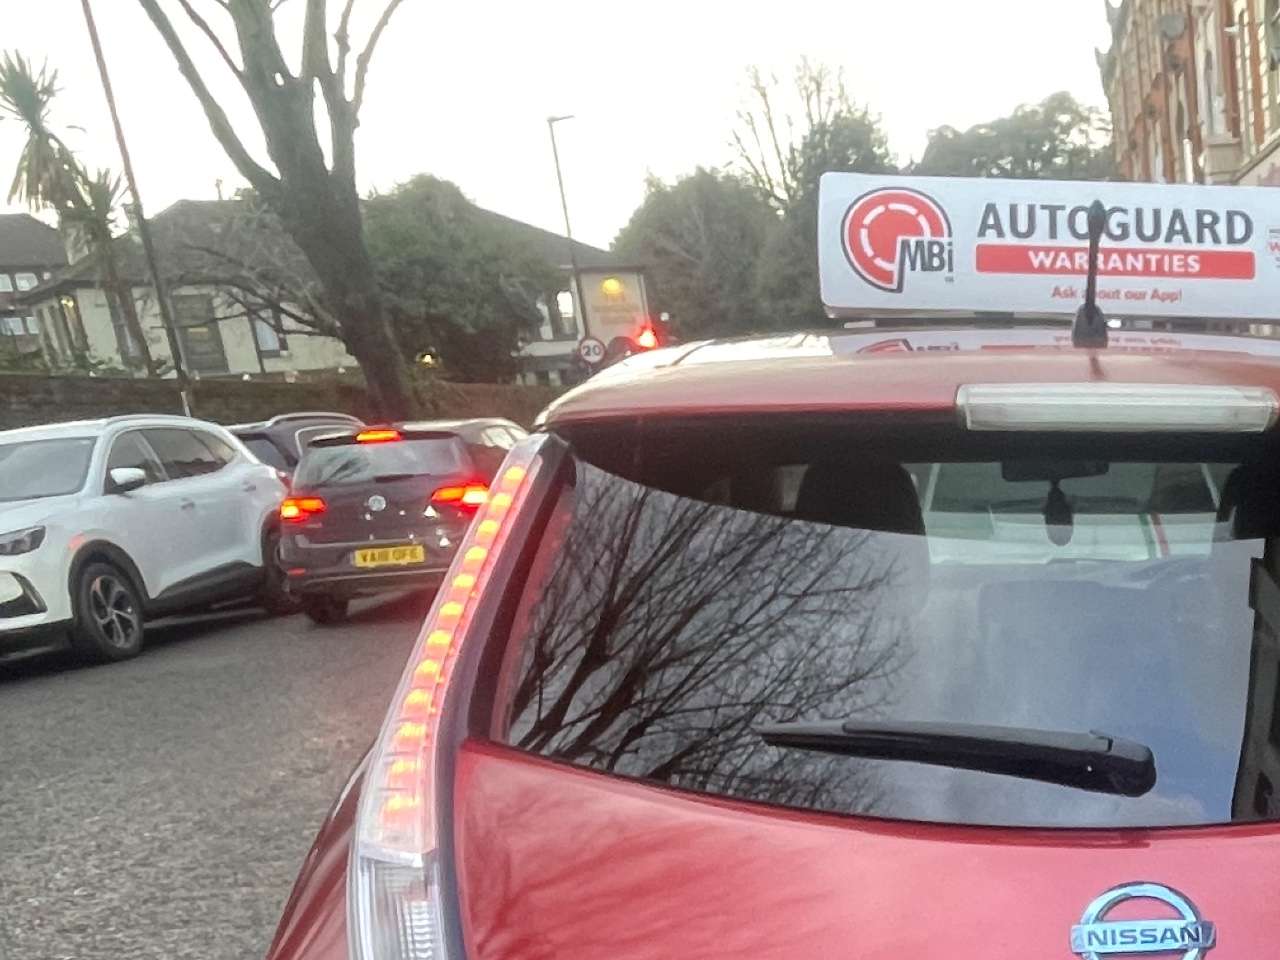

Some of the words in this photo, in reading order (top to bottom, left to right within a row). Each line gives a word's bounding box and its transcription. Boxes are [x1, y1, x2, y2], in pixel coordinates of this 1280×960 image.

[977, 202, 1254, 244] AUTOGUARD
[899, 239, 954, 272] MBi
[1028, 250, 1201, 273] WARRANTIES
[1052, 285, 1077, 299] Ask
[1124, 289, 1148, 300] our
[583, 344, 601, 356] 20
[1087, 926, 1200, 947] NISSAN
